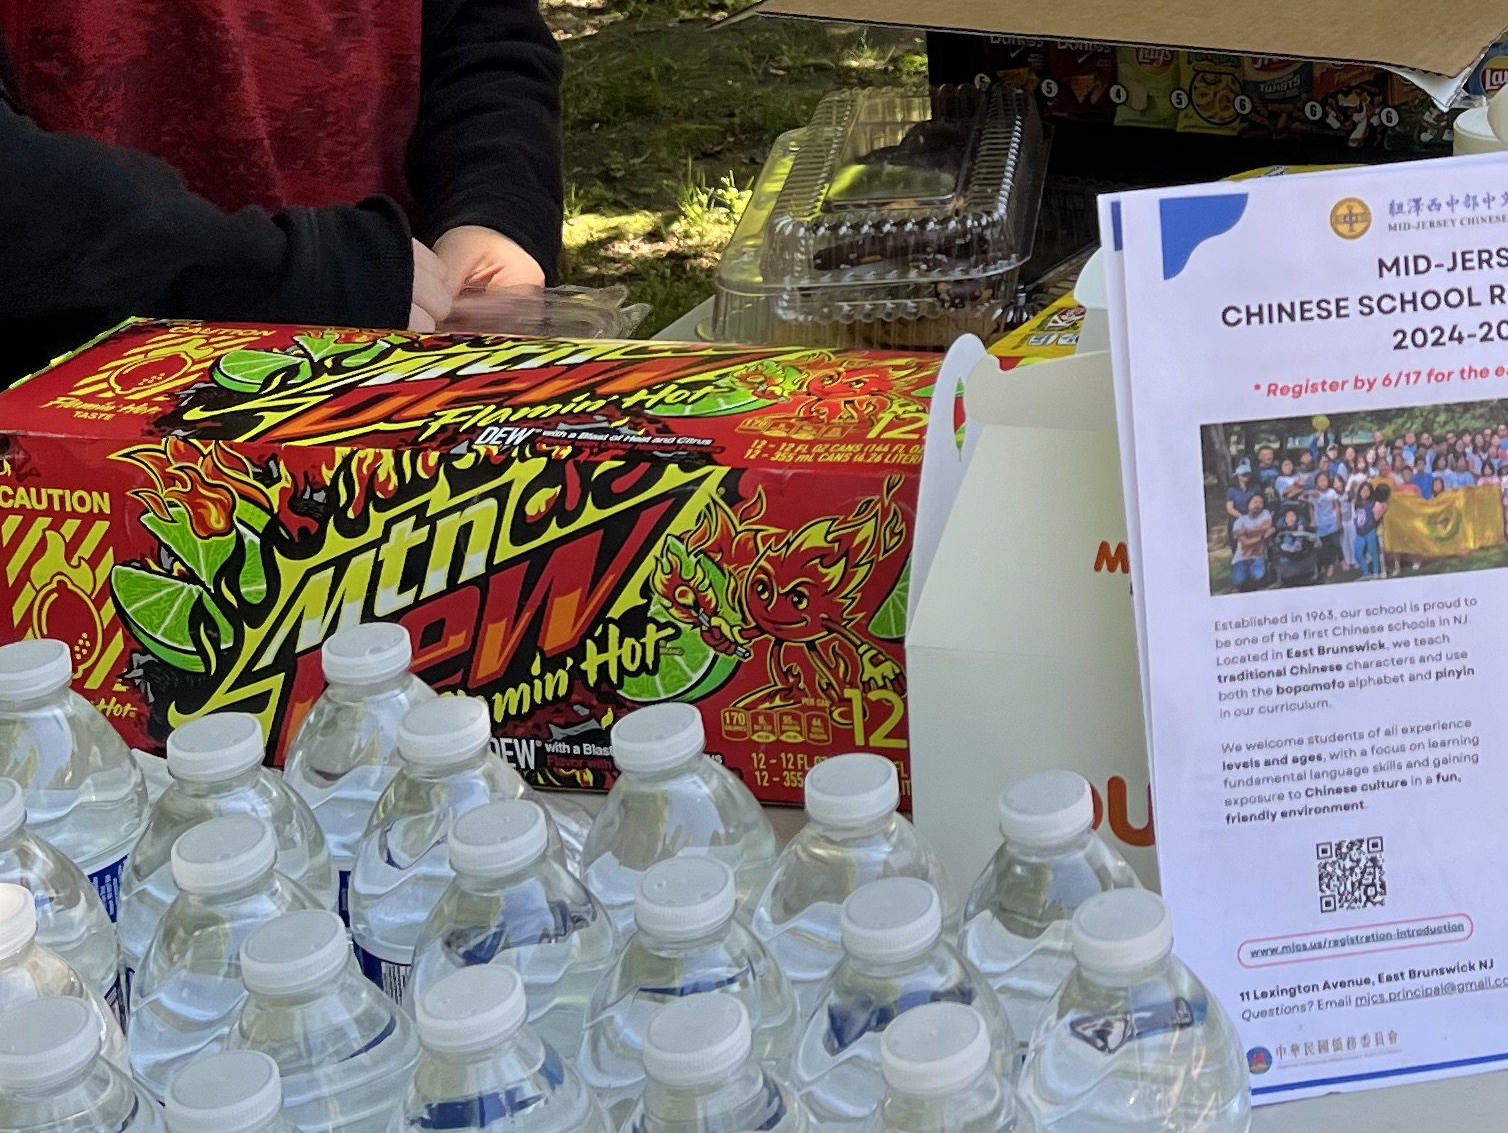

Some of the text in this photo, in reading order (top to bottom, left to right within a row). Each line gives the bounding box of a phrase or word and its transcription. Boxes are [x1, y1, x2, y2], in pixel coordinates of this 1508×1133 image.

[1388, 217, 1456, 232] MID-JERSEY
[1459, 214, 1507, 227] CHINESE
[1222, 297, 1349, 327] CHINESE
[1359, 287, 1481, 317] SCHOOL
[168, 326, 277, 337] CAUTION
[1267, 378, 1348, 399] Register
[1354, 375, 1377, 392] by
[1382, 370, 1421, 387] 6/17
[1427, 368, 1454, 383] for
[73, 411, 116, 421] TASTE
[419, 381, 732, 443] Flamin' Hot
[866, 411, 929, 439] 12
[543, 428, 567, 439] with
[578, 431, 609, 442] Blast
[626, 435, 649, 444] Heat
[651, 436, 675, 445] and
[676, 437, 713, 446] Citrus
[770, 450, 793, 462] 355
[817, 452, 852, 463] CANS
[0, 488, 111, 515] CAUTION
[1215, 597, 1460, 631] Established 1963, school proud
[1235, 614, 1471, 646] one first Chinese schools NJ.
[580, 622, 674, 688] Hot
[1217, 634, 1450, 666] Located East Brunswick, teach
[1217, 651, 1467, 684] traditional Chinese characters and use
[1219, 665, 1474, 701] both bopomofo alphabet and pinyin
[724, 710, 746, 726] 170
[845, 686, 908, 748] 12
[1259, 700, 1332, 714] curriculum.
[545, 741, 572, 754] with
[572, 745, 581, 755] a
[583, 743, 613, 757] Blast
[1221, 720, 1471, 754] We welcome students all experience
[752, 752, 767, 770] 12
[782, 752, 794, 770] 12
[1223, 736, 1479, 771] levels and ages, with focus learning
[755, 770, 803, 788] 12 355
[1224, 753, 1479, 788] fundamental language skills and gaining
[1225, 772, 1461, 807] exposure Chinese culture fun,
[1226, 801, 1368, 824] friendly environment.
[1240, 958, 1493, 1002] 11 Lexington Avenue, East Brunswick NJ
[1242, 1001, 1313, 1022] Questions?
[1317, 995, 1351, 1010] Email
